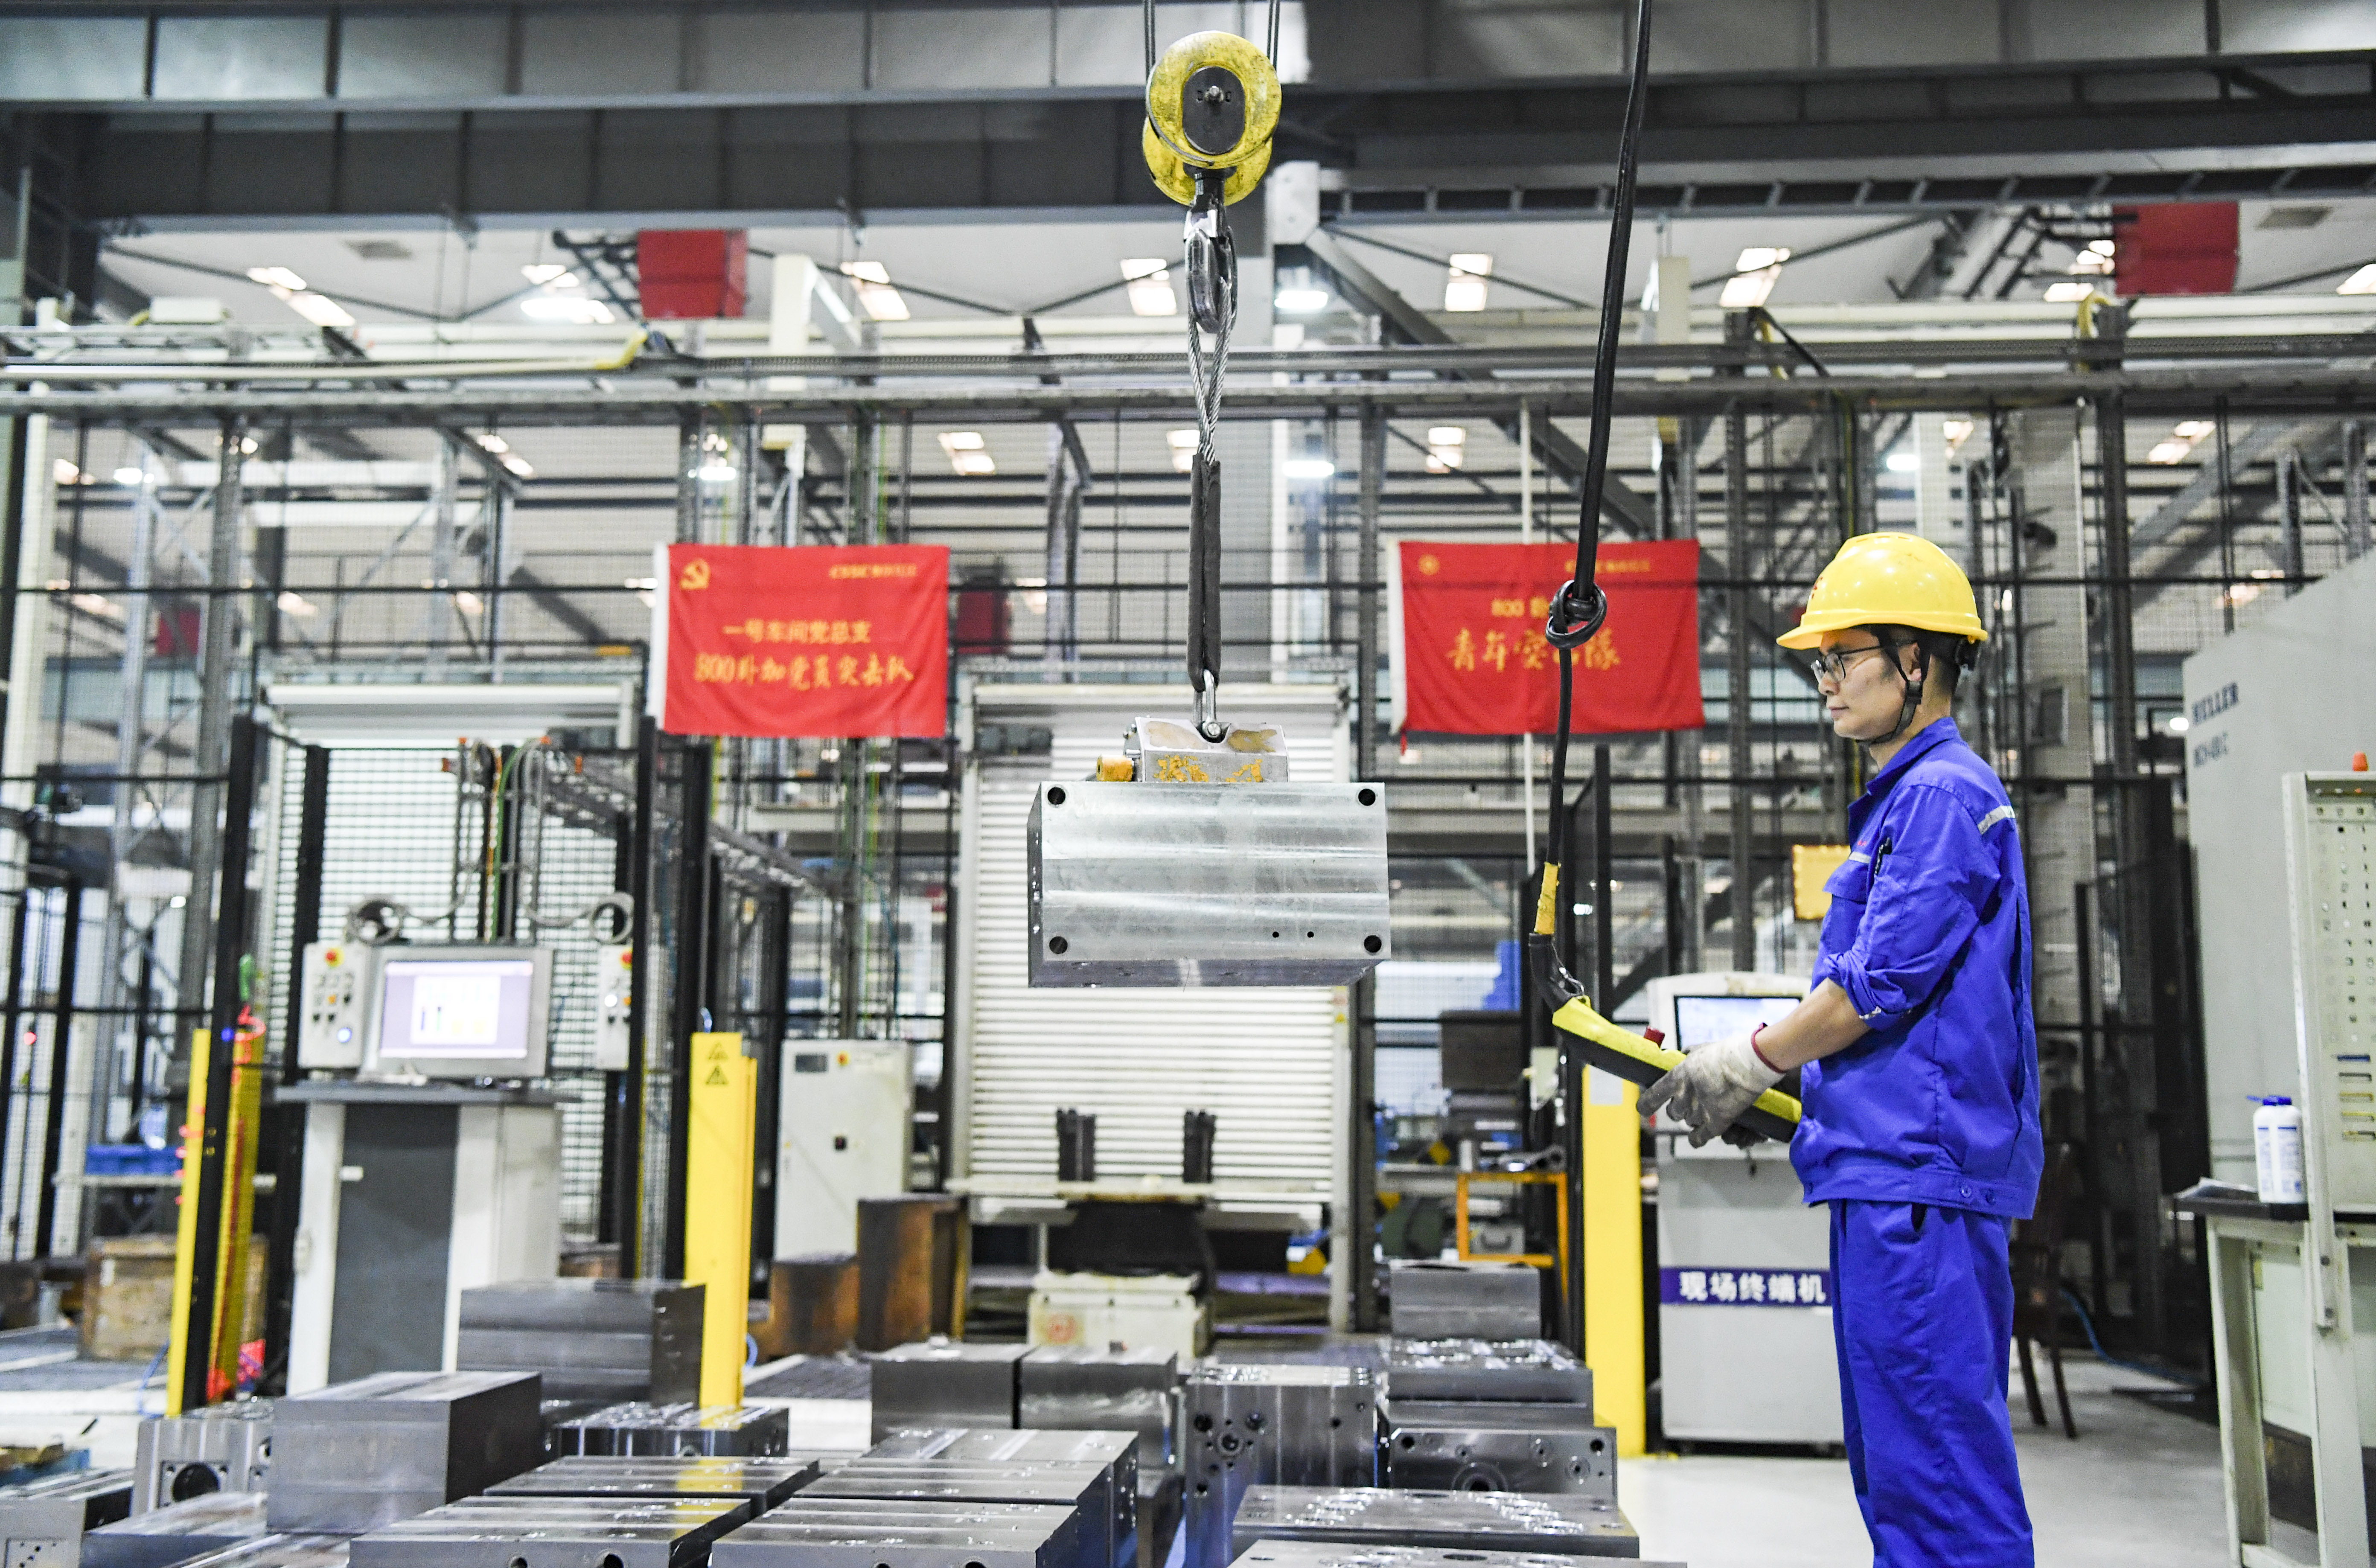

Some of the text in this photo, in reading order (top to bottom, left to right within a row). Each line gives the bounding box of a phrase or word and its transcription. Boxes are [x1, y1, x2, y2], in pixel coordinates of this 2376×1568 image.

[723, 618, 872, 645] 一号车间党总支
[1679, 1271, 1826, 1303] 现场终端机
